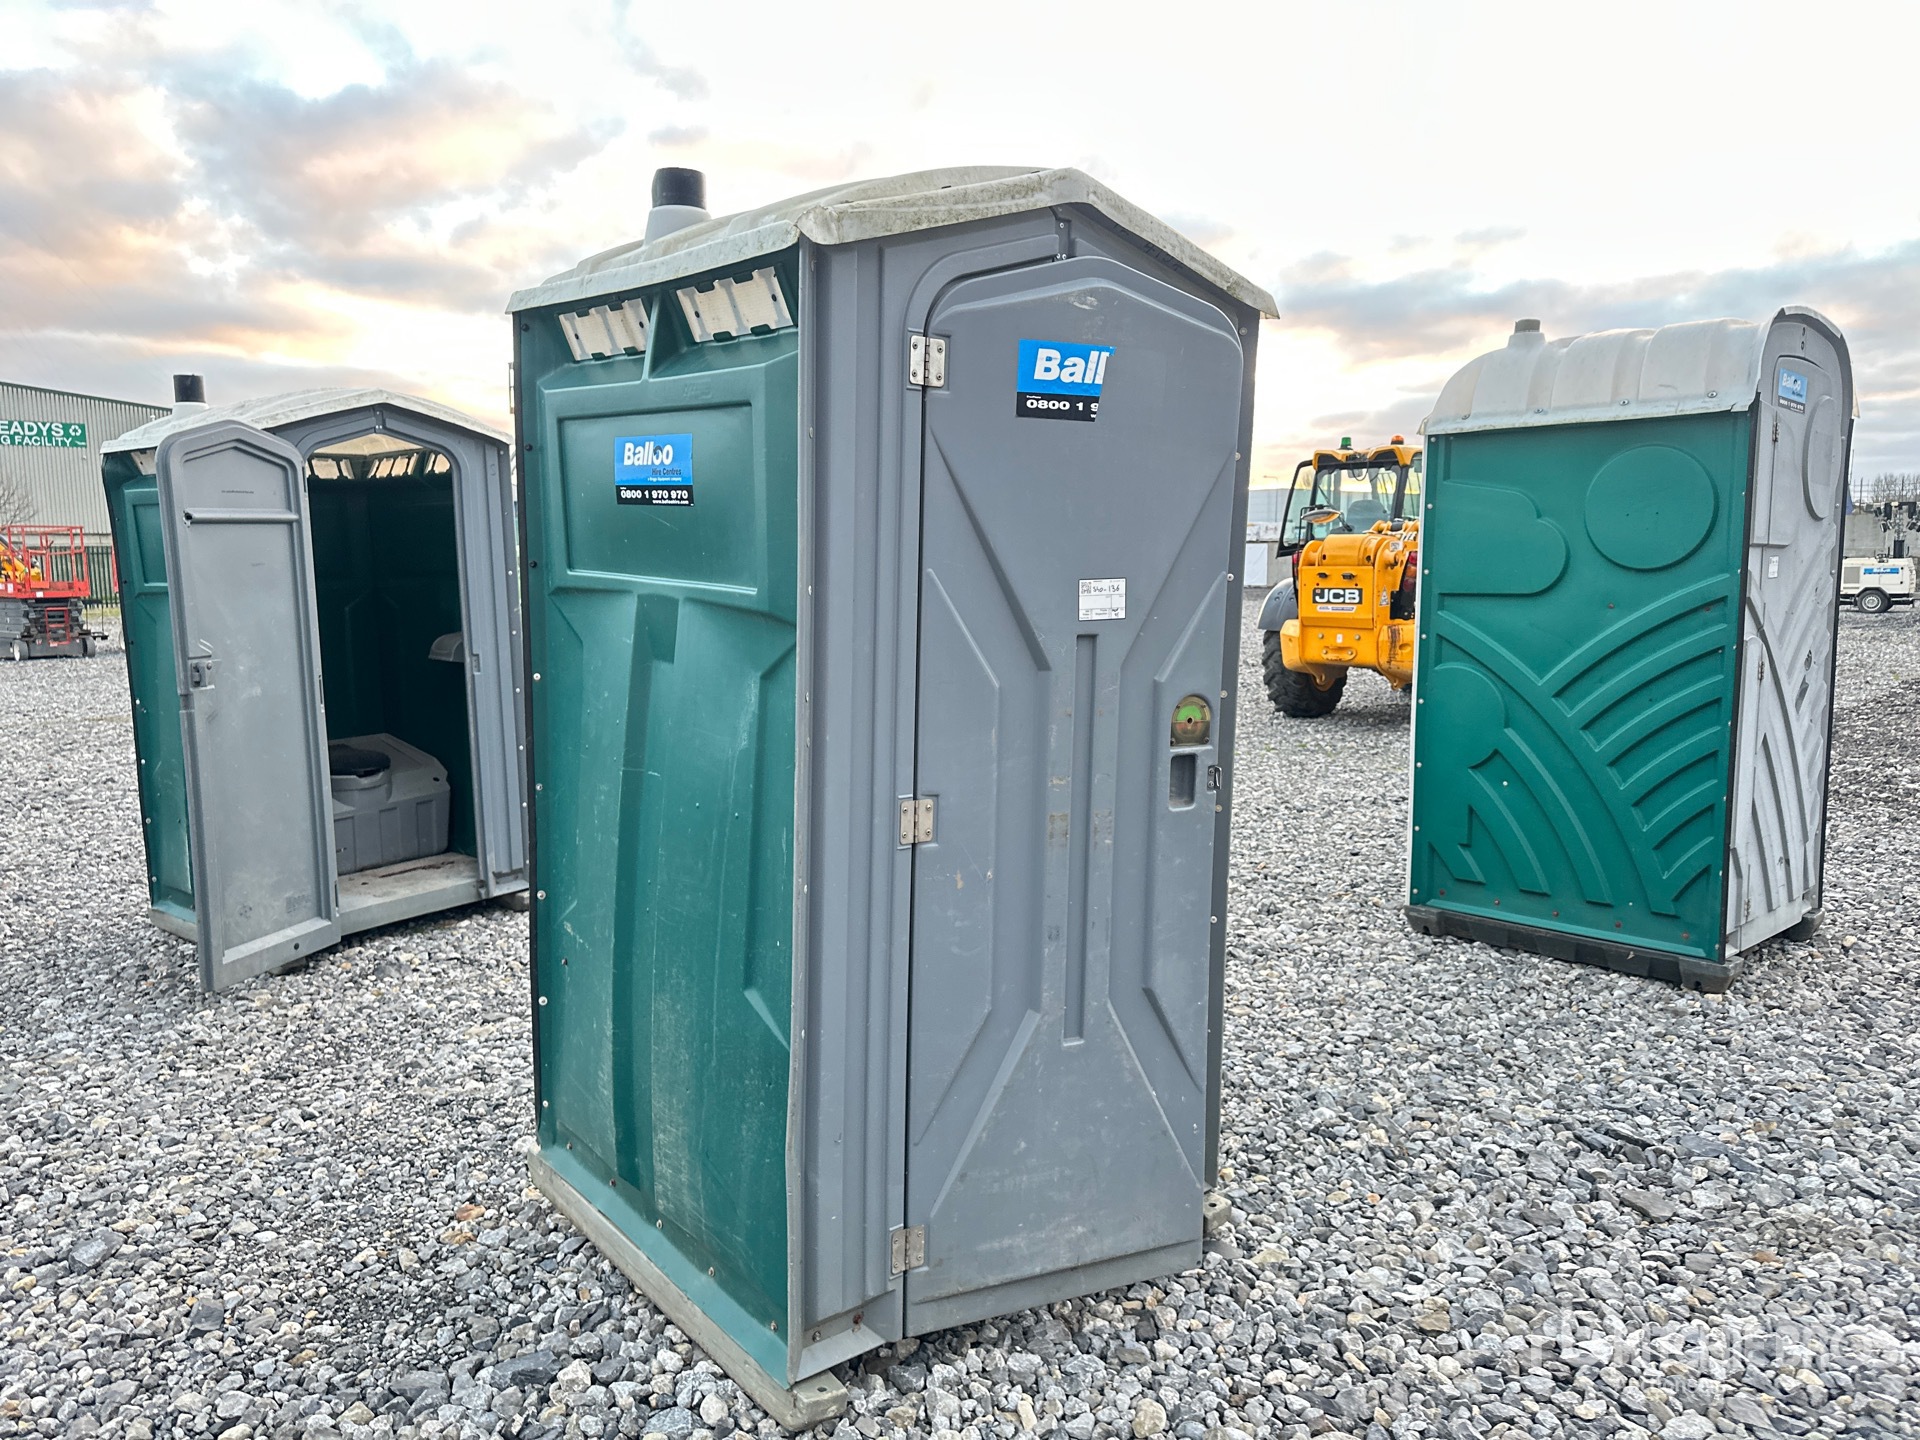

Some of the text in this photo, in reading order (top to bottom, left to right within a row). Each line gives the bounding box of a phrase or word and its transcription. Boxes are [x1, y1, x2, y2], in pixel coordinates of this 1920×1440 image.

[1026, 399, 1070, 411] 0800
[1076, 402, 1084, 411] 1
[0, 421, 64, 437] EADYS
[14, 435, 72, 447] FACILITY
[623, 441, 674, 466] Balloo
[651, 468, 662, 476] Hire
[620, 490, 688, 499] 0800 1 970 970
[1315, 589, 1360, 603] JCB
